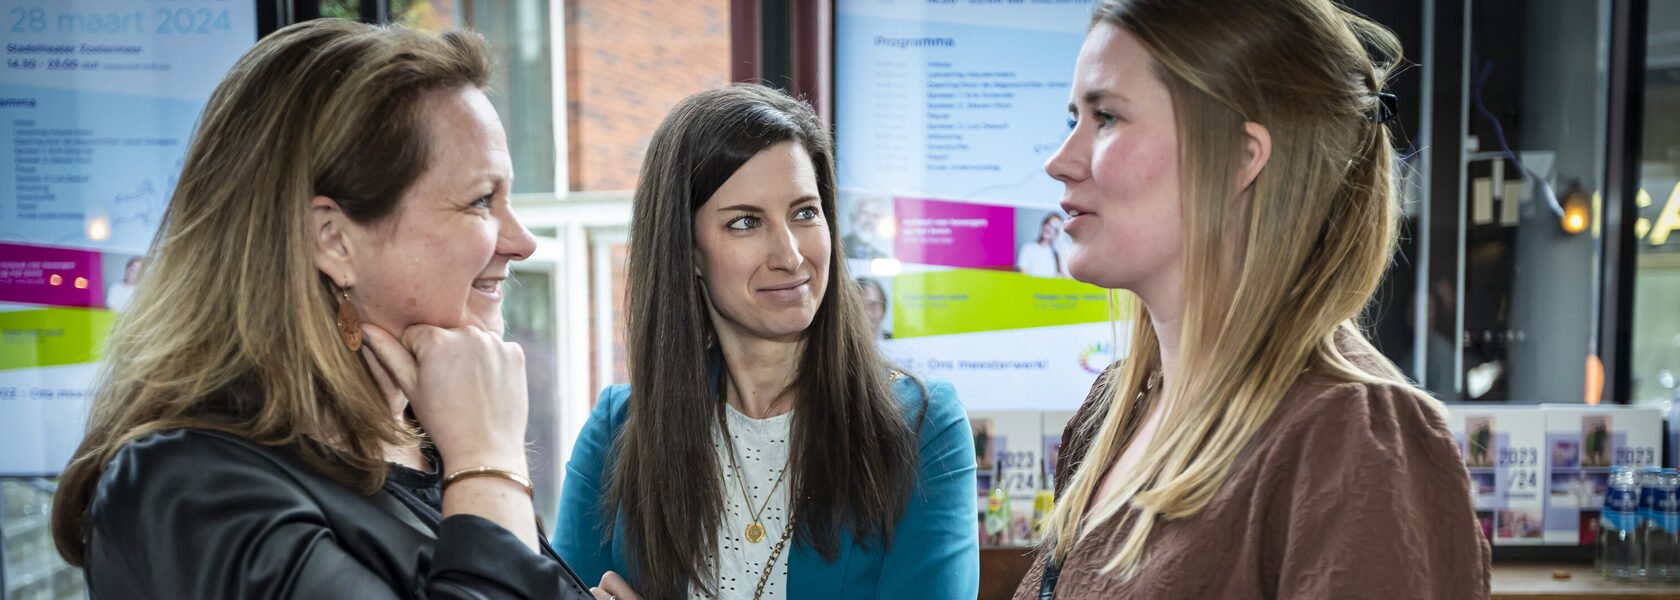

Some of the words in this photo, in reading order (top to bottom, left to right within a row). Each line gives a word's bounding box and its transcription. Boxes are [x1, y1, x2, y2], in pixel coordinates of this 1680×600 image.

[9, 7, 46, 33] 28
[57, 11, 144, 34] maart
[156, 7, 231, 35] 2024
[6, 42, 76, 55] Stadstheater
[79, 43, 143, 55] Zoetermeer
[873, 35, 956, 49] Programma
[996, 450, 1035, 468] 2023
[1498, 447, 1539, 468] 2023
[1615, 447, 1655, 467] 2023
[1508, 470, 1538, 489] /24
